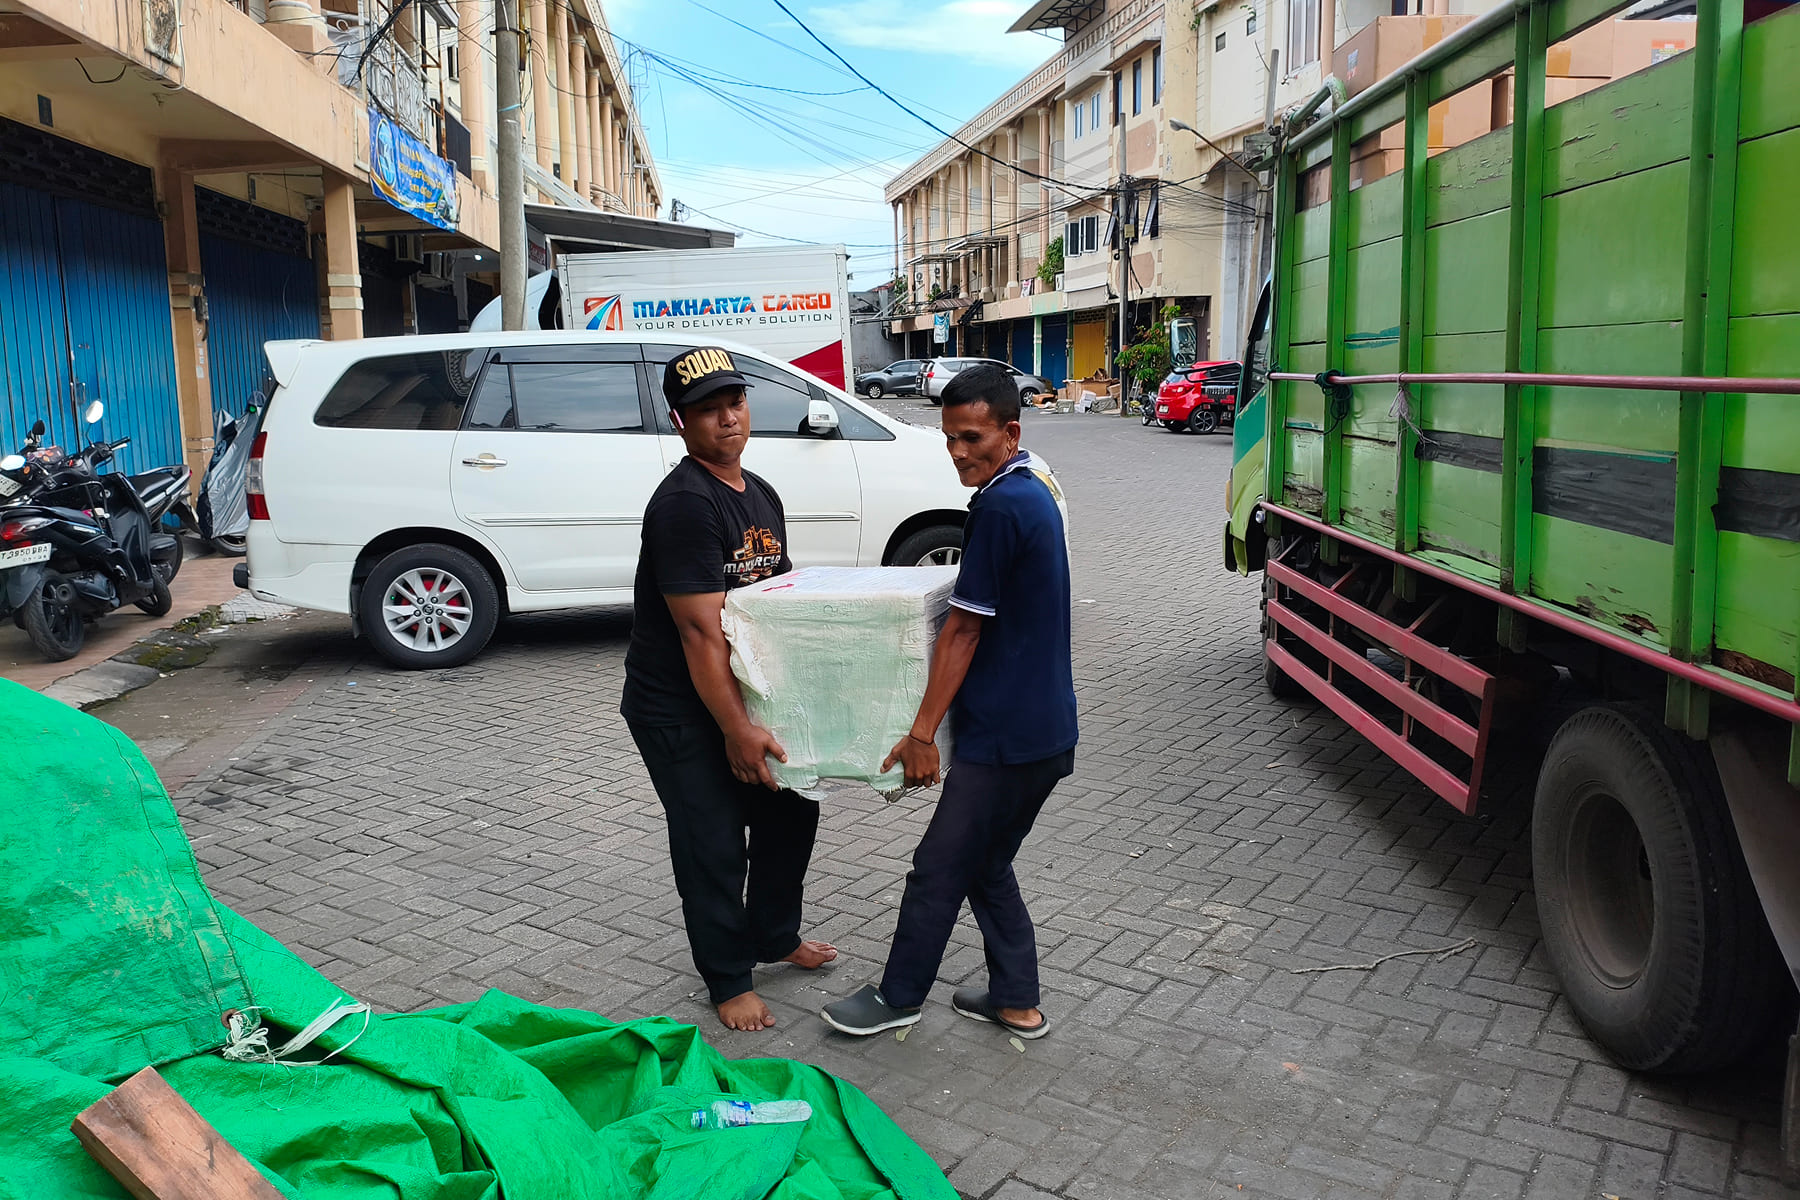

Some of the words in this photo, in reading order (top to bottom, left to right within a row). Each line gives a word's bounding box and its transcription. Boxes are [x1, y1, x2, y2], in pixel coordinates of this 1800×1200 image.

[633, 296, 756, 318] MAKHARYA
[762, 292, 832, 313] CARGO
[636, 320, 675, 331] YOUR
[682, 317, 752, 329] DELIVERY
[760, 313, 832, 325] SOLUTION
[676, 349, 734, 385] SQUAD
